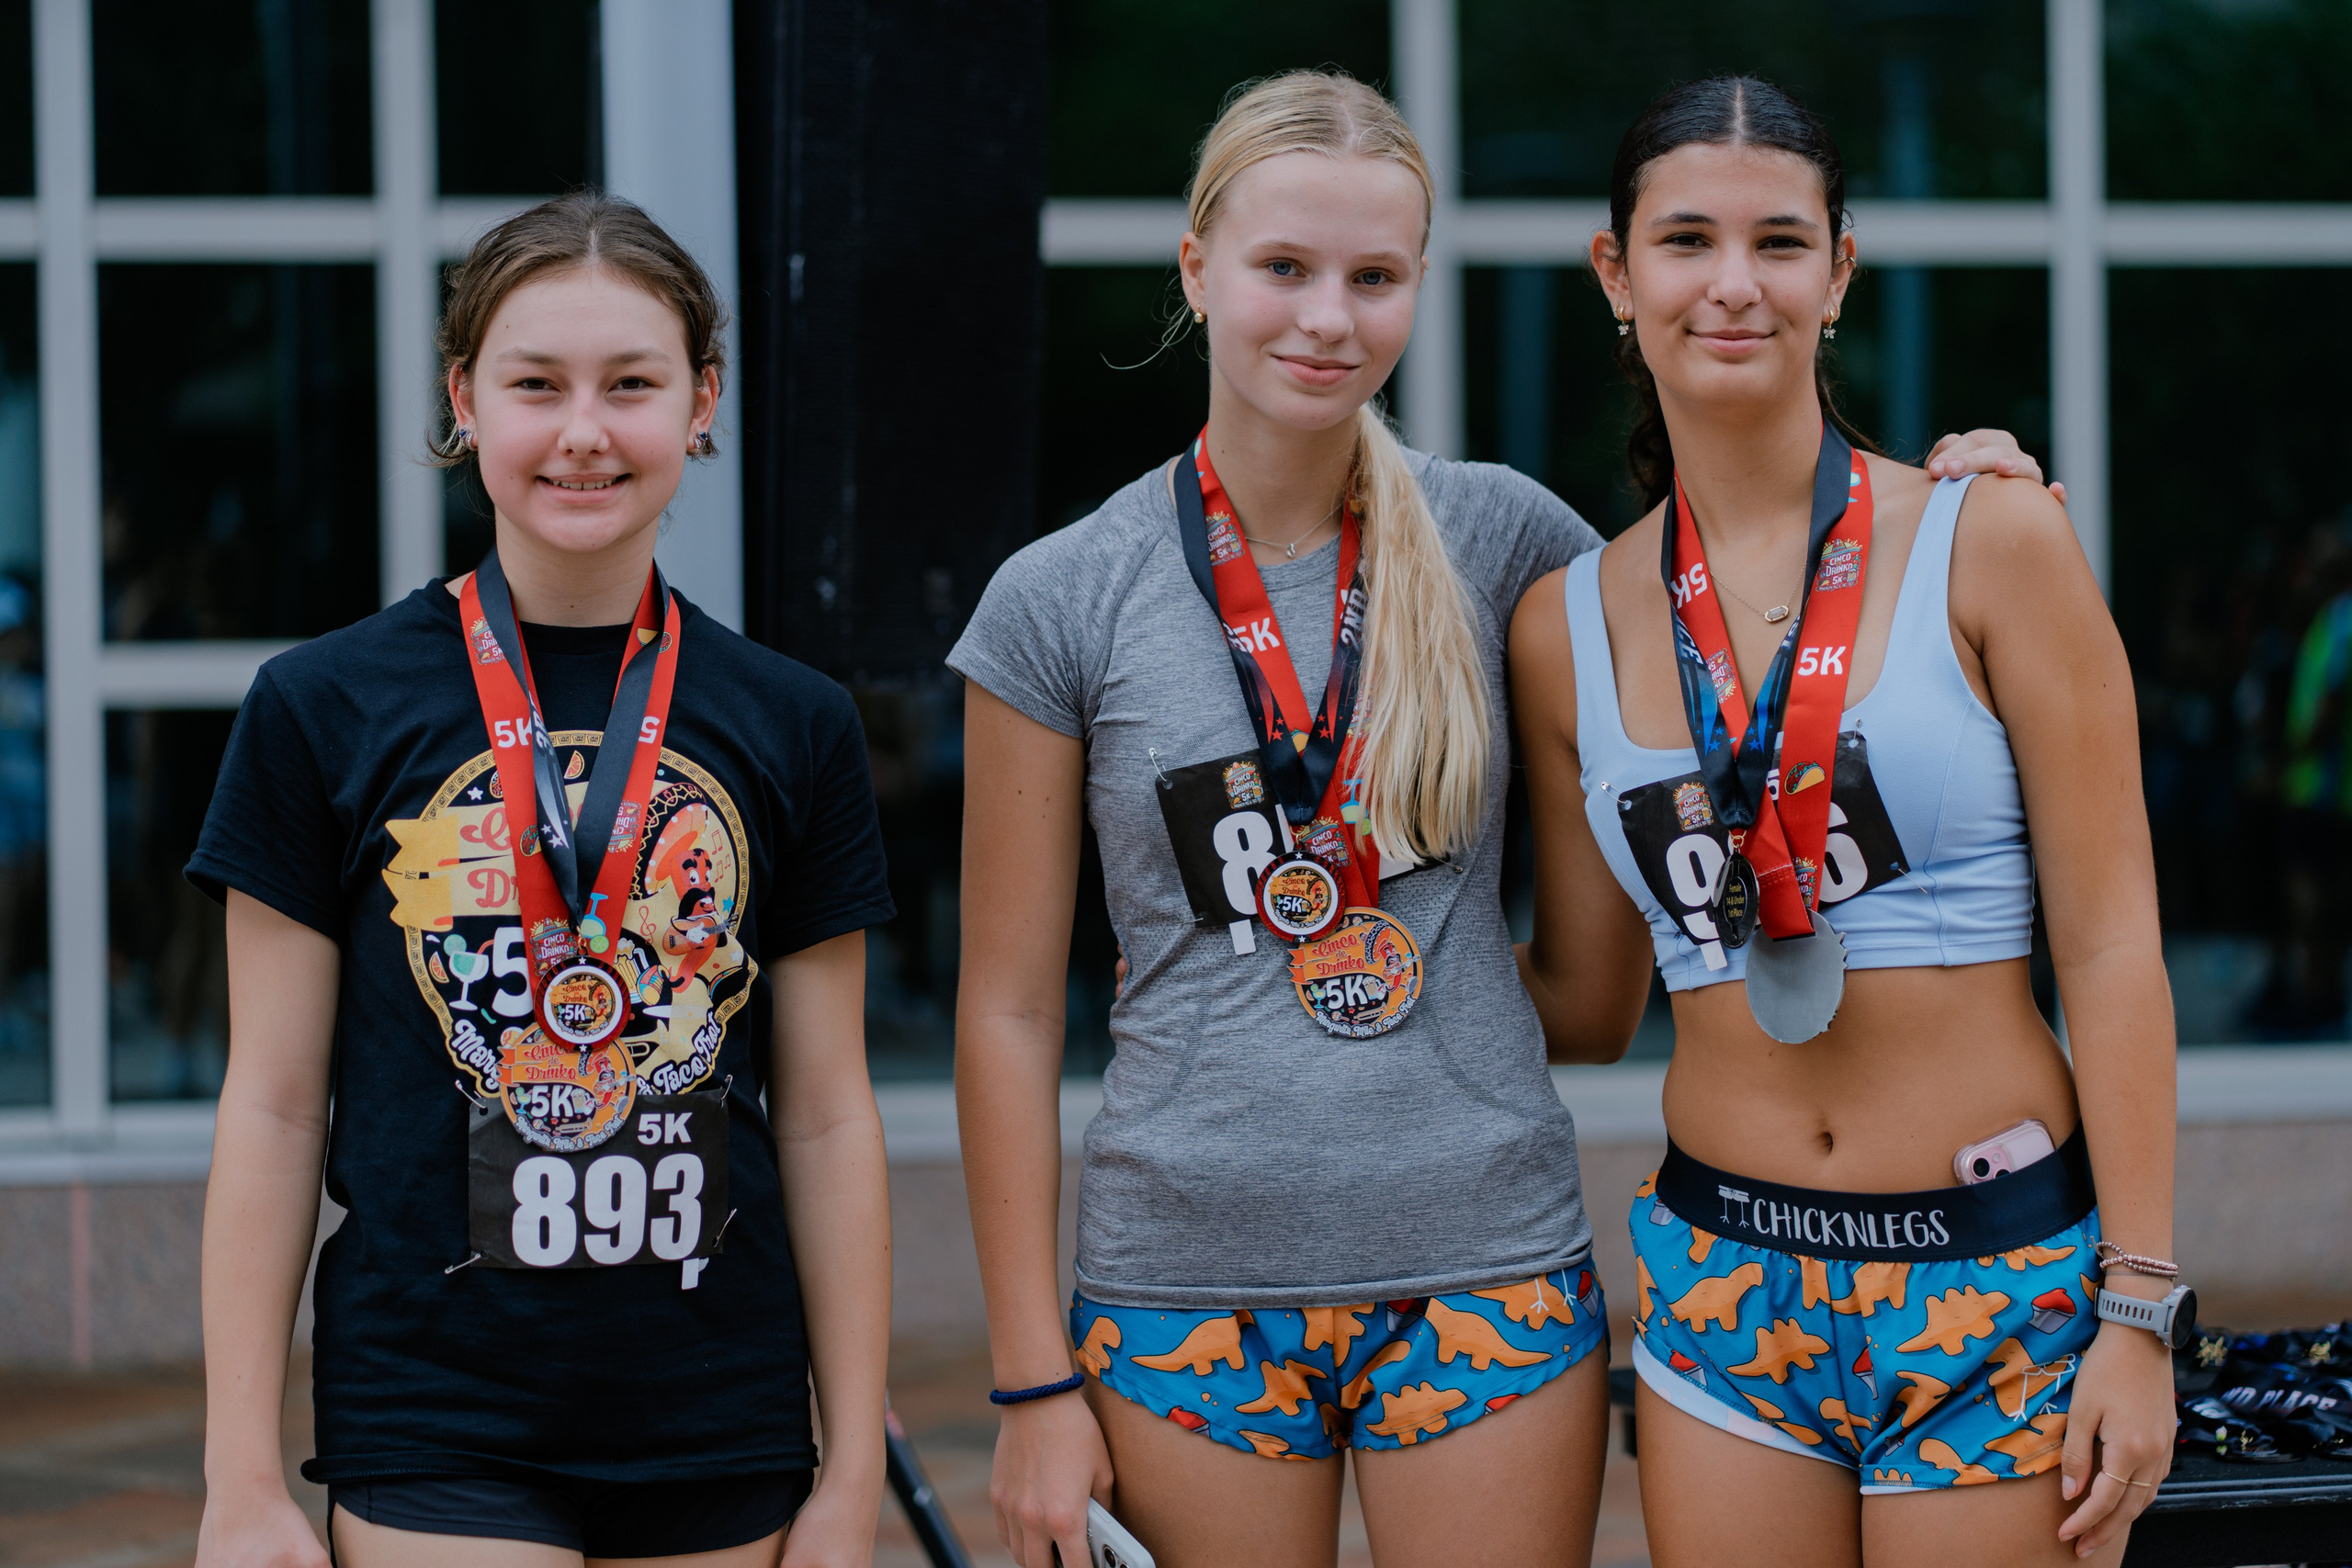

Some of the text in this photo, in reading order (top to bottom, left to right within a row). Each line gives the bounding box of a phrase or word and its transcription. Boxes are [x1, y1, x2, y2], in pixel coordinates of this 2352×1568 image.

[1826, 562, 1853, 577] DRINKO
[1829, 553, 1851, 566] CINCO
[1670, 562, 1708, 609] 5K
[1832, 575, 1843, 585] 5K
[1232, 617, 1281, 654] 5K
[1797, 646, 1847, 676] 5K
[639, 716, 660, 744] 5
[1312, 830, 1332, 845] CINCO
[1282, 897, 1303, 913] 5K
[543, 933, 565, 946] CINCO
[1312, 933, 1359, 957] Cinco
[541, 944, 570, 959] DRINKO
[1316, 955, 1367, 976] Drinko
[1326, 975, 1368, 1010] 5K
[564, 1004, 586, 1021] 5K
[524, 1043, 575, 1061] Cinc
[653, 1056, 707, 1095] Taco
[694, 1010, 721, 1063] Trot
[525, 1063, 578, 1080] Drinko
[530, 1085, 573, 1118] 5K
[637, 1112, 693, 1145] 5K
[512, 1153, 704, 1267] 893
[1753, 1198, 1950, 1248] CHICKNLEGS
